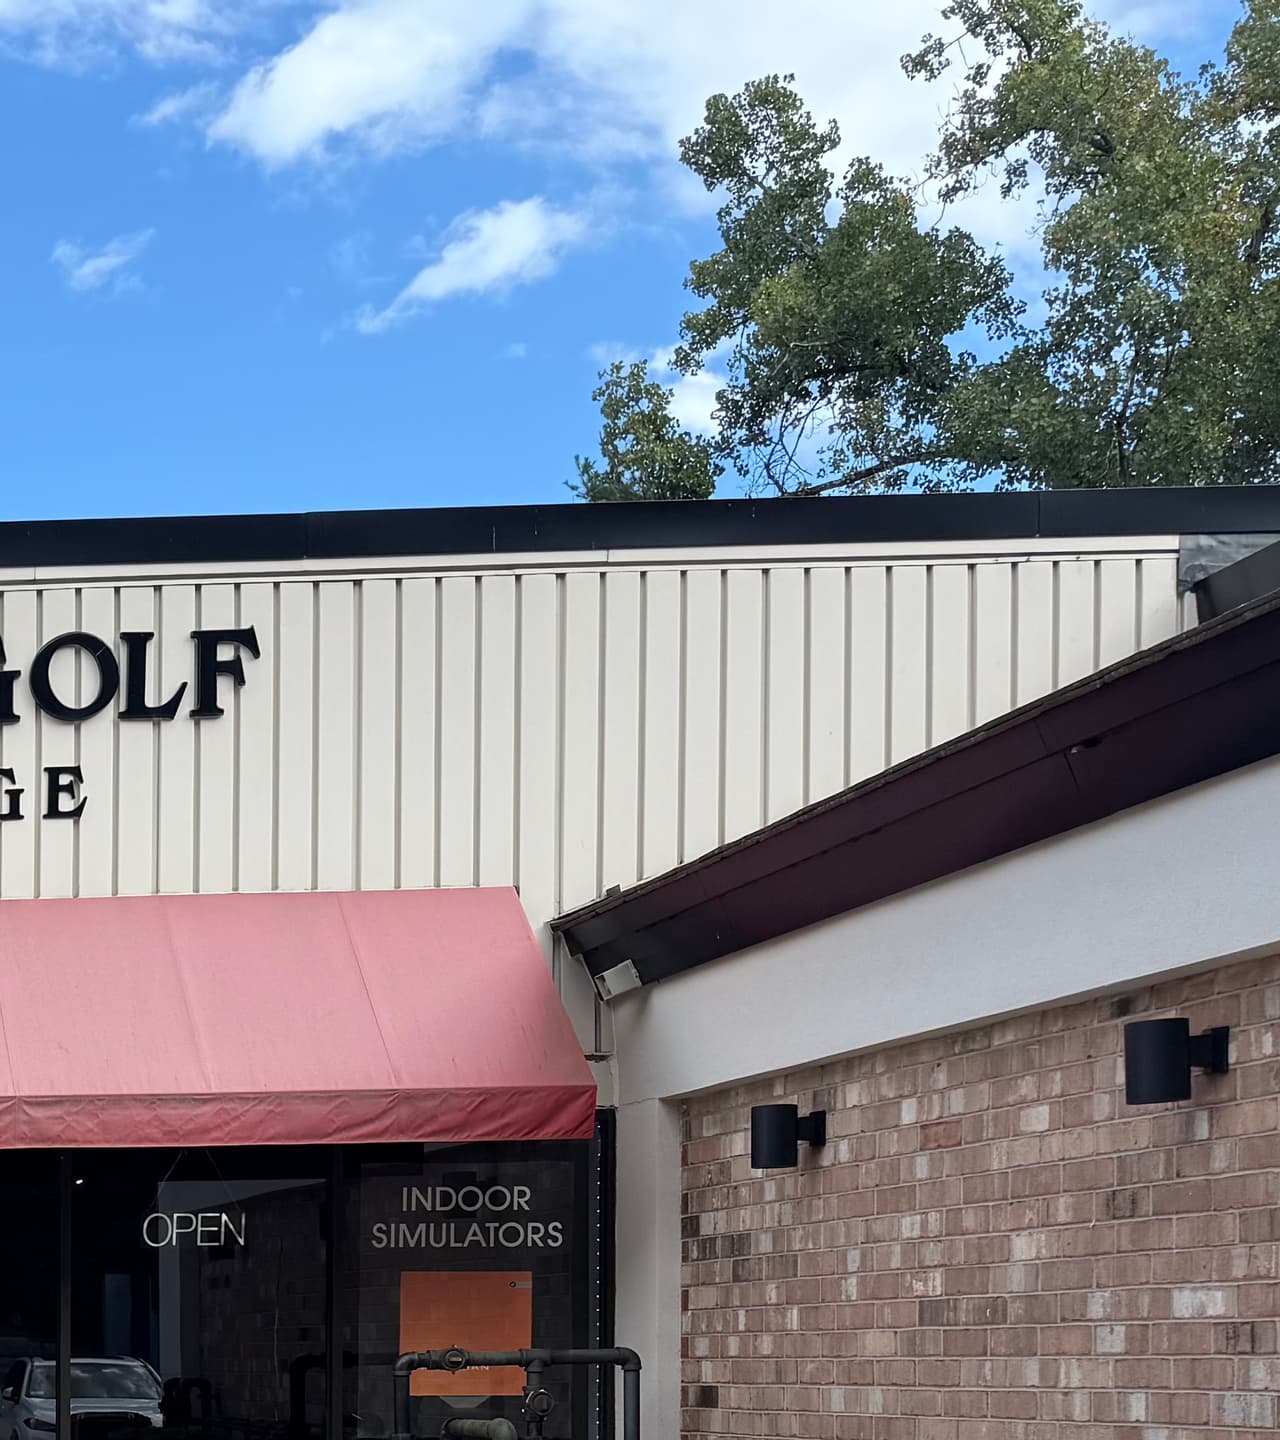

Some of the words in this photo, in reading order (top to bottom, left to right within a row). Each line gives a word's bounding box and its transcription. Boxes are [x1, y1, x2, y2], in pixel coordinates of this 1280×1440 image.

[402, 1185, 531, 1211] INDOOR
[143, 1212, 245, 1247] OPEN
[371, 1222, 563, 1248] SIMULATORS
